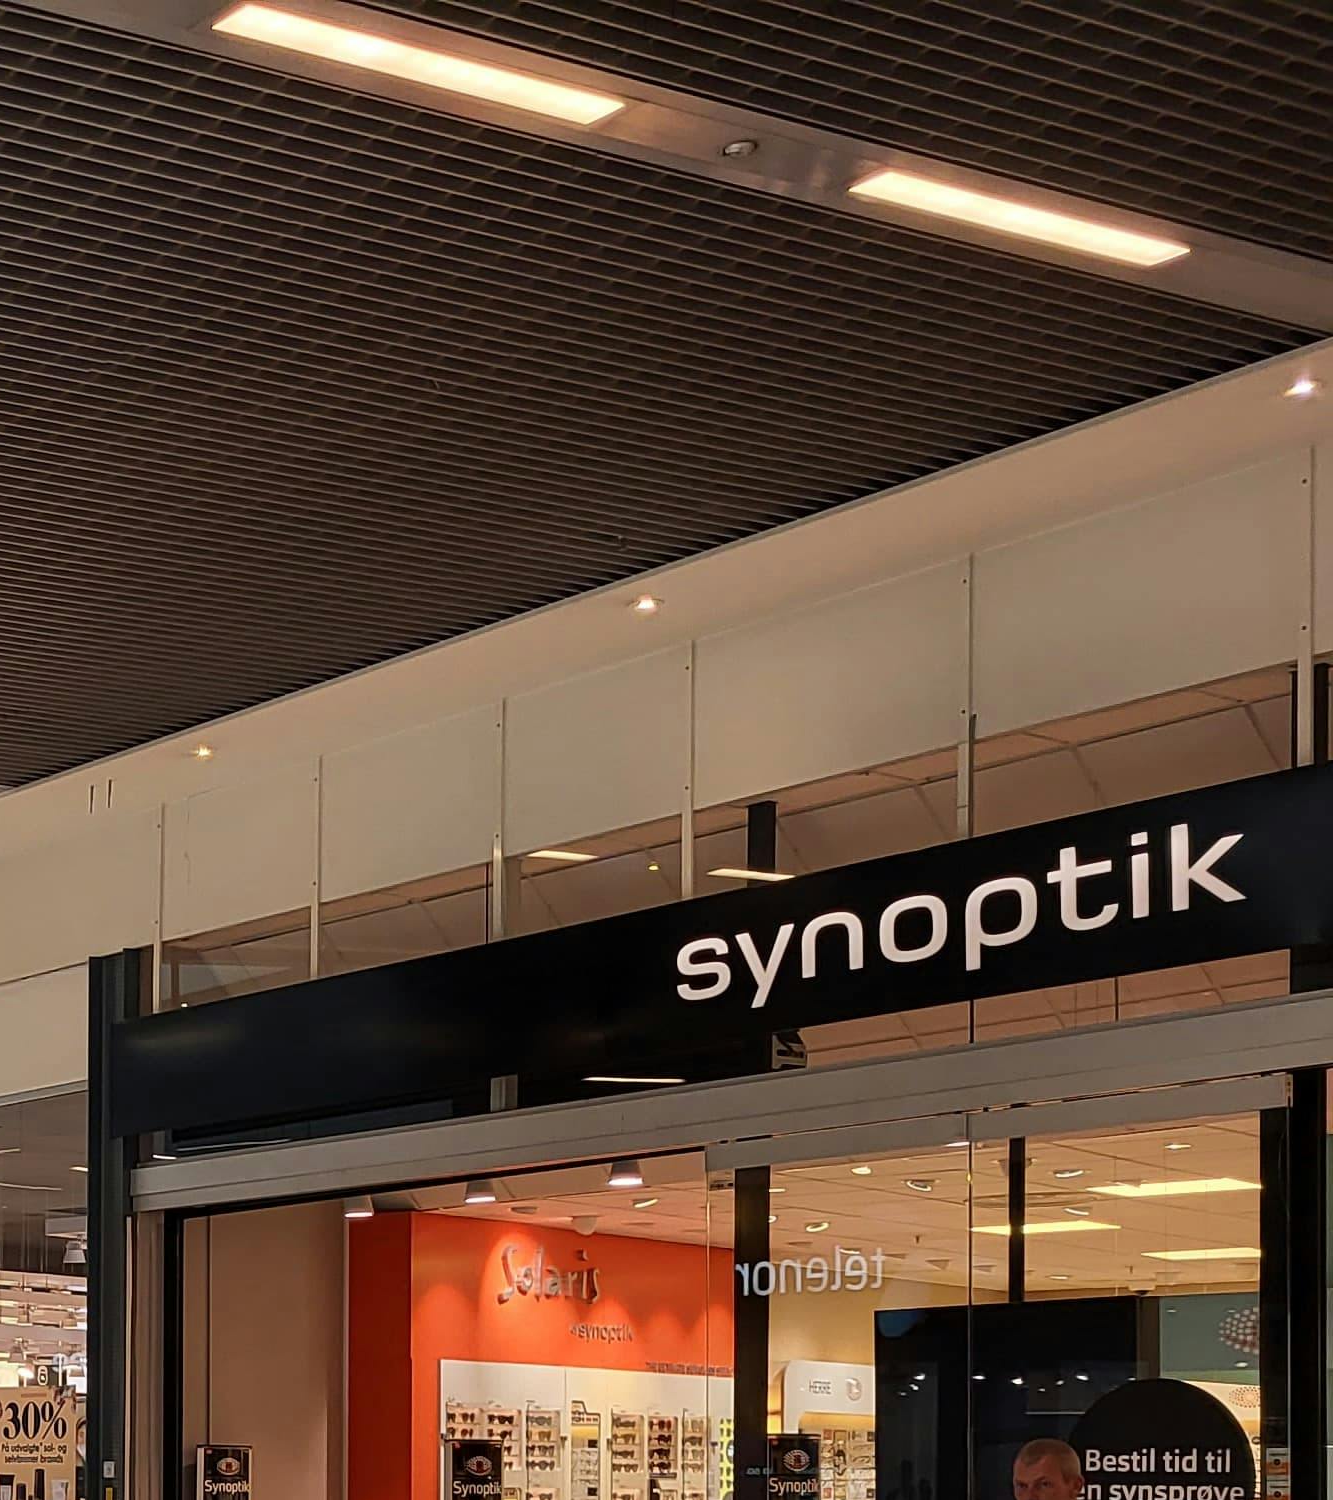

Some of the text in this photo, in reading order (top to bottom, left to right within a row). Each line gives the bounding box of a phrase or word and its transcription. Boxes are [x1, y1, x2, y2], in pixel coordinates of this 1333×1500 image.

[675, 823, 1247, 1008] synoptik
[497, 1244, 600, 1305] Solaris
[3, 1400, 67, 1440] 30%
[1086, 1448, 1231, 1473] Bestil tid til
[204, 1480, 252, 1495] Synoptik
[453, 1481, 502, 1498] Synoptik
[769, 1477, 819, 1496] Synoptik
[1076, 1484, 1101, 1500] en
